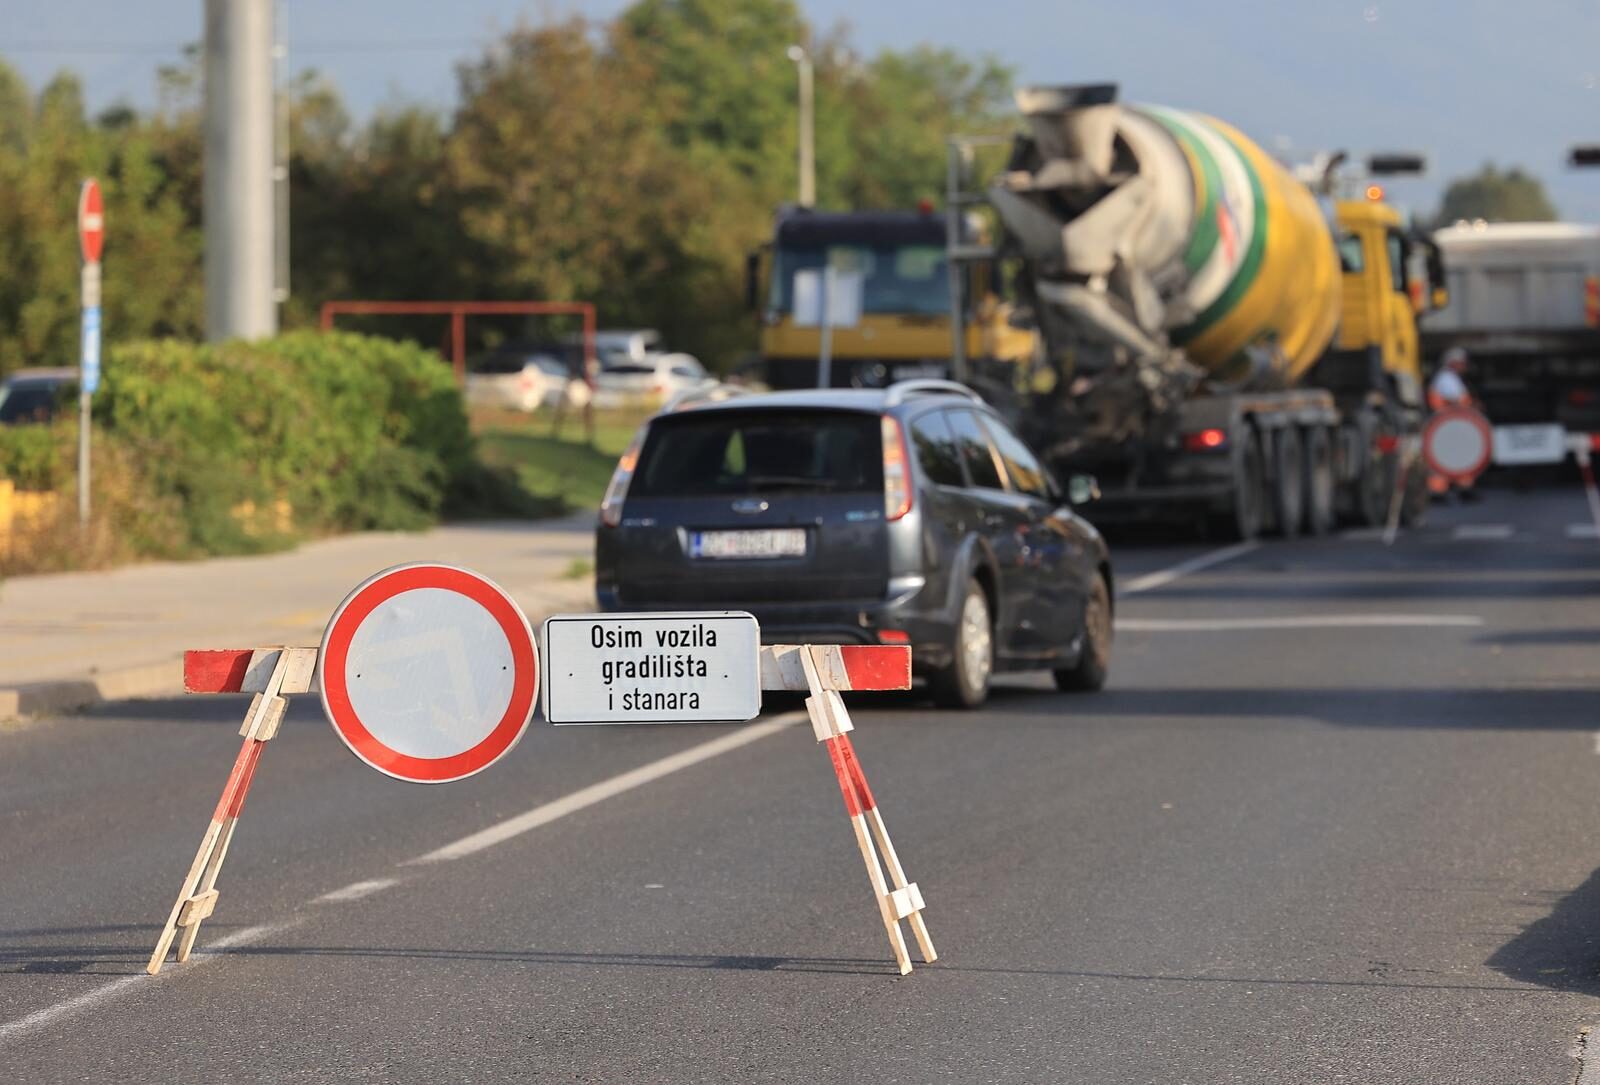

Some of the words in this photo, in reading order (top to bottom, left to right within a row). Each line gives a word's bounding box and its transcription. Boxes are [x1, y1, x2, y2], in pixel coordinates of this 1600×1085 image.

[591, 624, 642, 649] Osim
[655, 623, 717, 648] vozila
[602, 654, 707, 685] gradilišta
[608, 687, 613, 711] i
[622, 687, 700, 711] stanara
